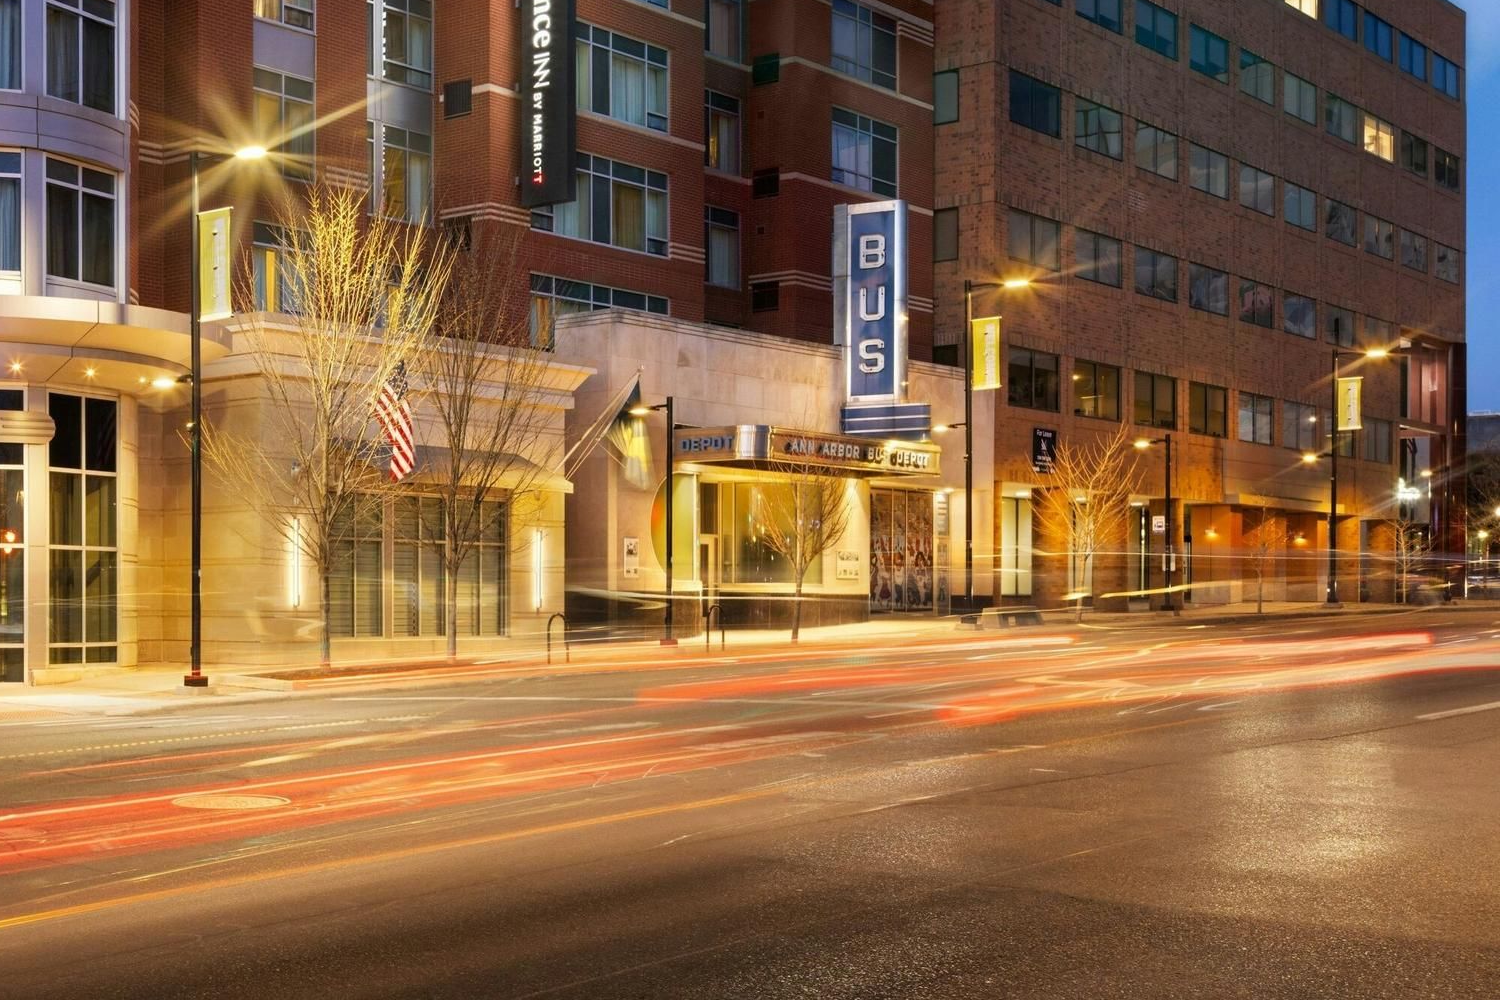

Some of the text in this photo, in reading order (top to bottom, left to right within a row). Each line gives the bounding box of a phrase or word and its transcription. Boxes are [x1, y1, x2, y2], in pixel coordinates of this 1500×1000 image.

[532, 51, 551, 89] INN
[532, 92, 543, 109] BY
[532, 114, 543, 185] MARRIOTT
[859, 234, 886, 374] BUS
[680, 436, 733, 452] DEPOT
[791, 439, 815, 454] ANN
[822, 442, 860, 459] ARBOR
[896, 449, 930, 466] DEPOT
